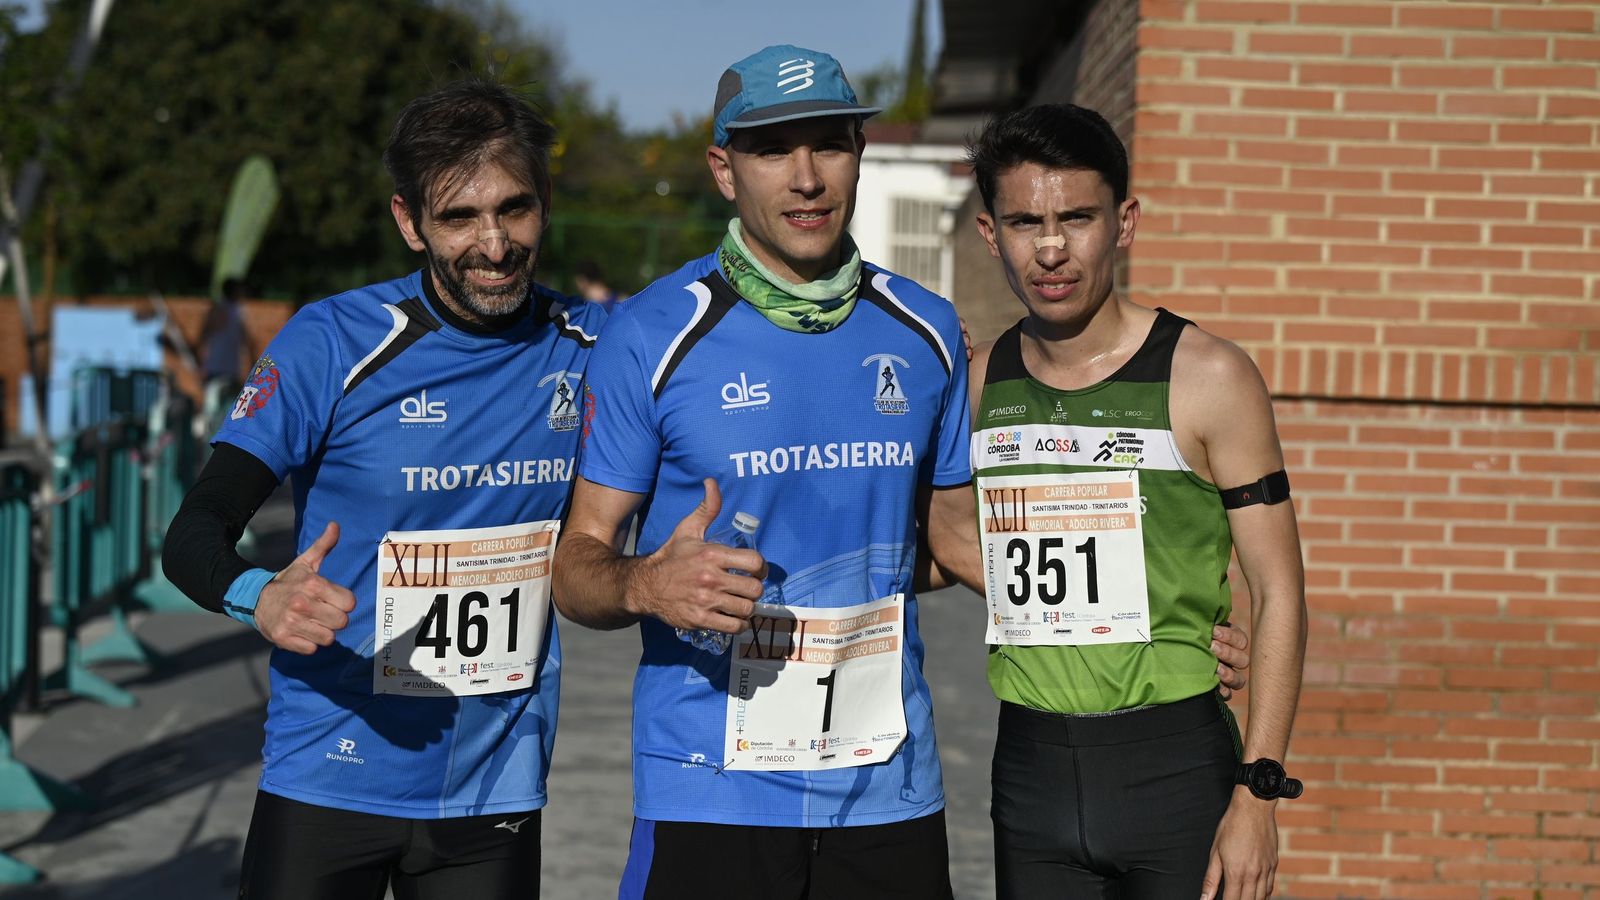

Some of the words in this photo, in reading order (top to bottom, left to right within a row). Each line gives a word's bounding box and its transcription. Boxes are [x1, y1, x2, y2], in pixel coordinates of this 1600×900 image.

[996, 405, 1026, 415] IMDECO
[1104, 410, 1120, 418] LSC
[988, 444, 1020, 454] CÓRDOBA
[1035, 438, 1077, 452] AOSSA
[730, 441, 914, 478] TROTASIERRA
[1044, 486, 1075, 498] CARRERA
[1077, 485, 1108, 497] POPULAR
[986, 488, 1028, 533] XLII
[1092, 502, 1128, 510] TRINITARIOS
[1029, 520, 1064, 531] MEMORIAL
[471, 540, 505, 553] CARRERA
[505, 536, 534, 549] POPULAR
[387, 543, 451, 587] XLII
[456, 559, 489, 568] SANTISIMA
[490, 556, 515, 564] TRINIDAD
[519, 550, 548, 561] TRINITARIOS
[451, 571, 491, 587] MEMORIAL
[1006, 536, 1099, 606] 351
[415, 588, 519, 658] 461
[829, 619, 857, 632] CARRERA
[857, 612, 880, 627] POPULAR
[743, 616, 808, 662] XLII
[844, 632, 862, 642] TRINIDAD
[865, 626, 893, 636] TRINITARIOS
[806, 651, 843, 662] MEMORIAL
[817, 669, 836, 732] 1
